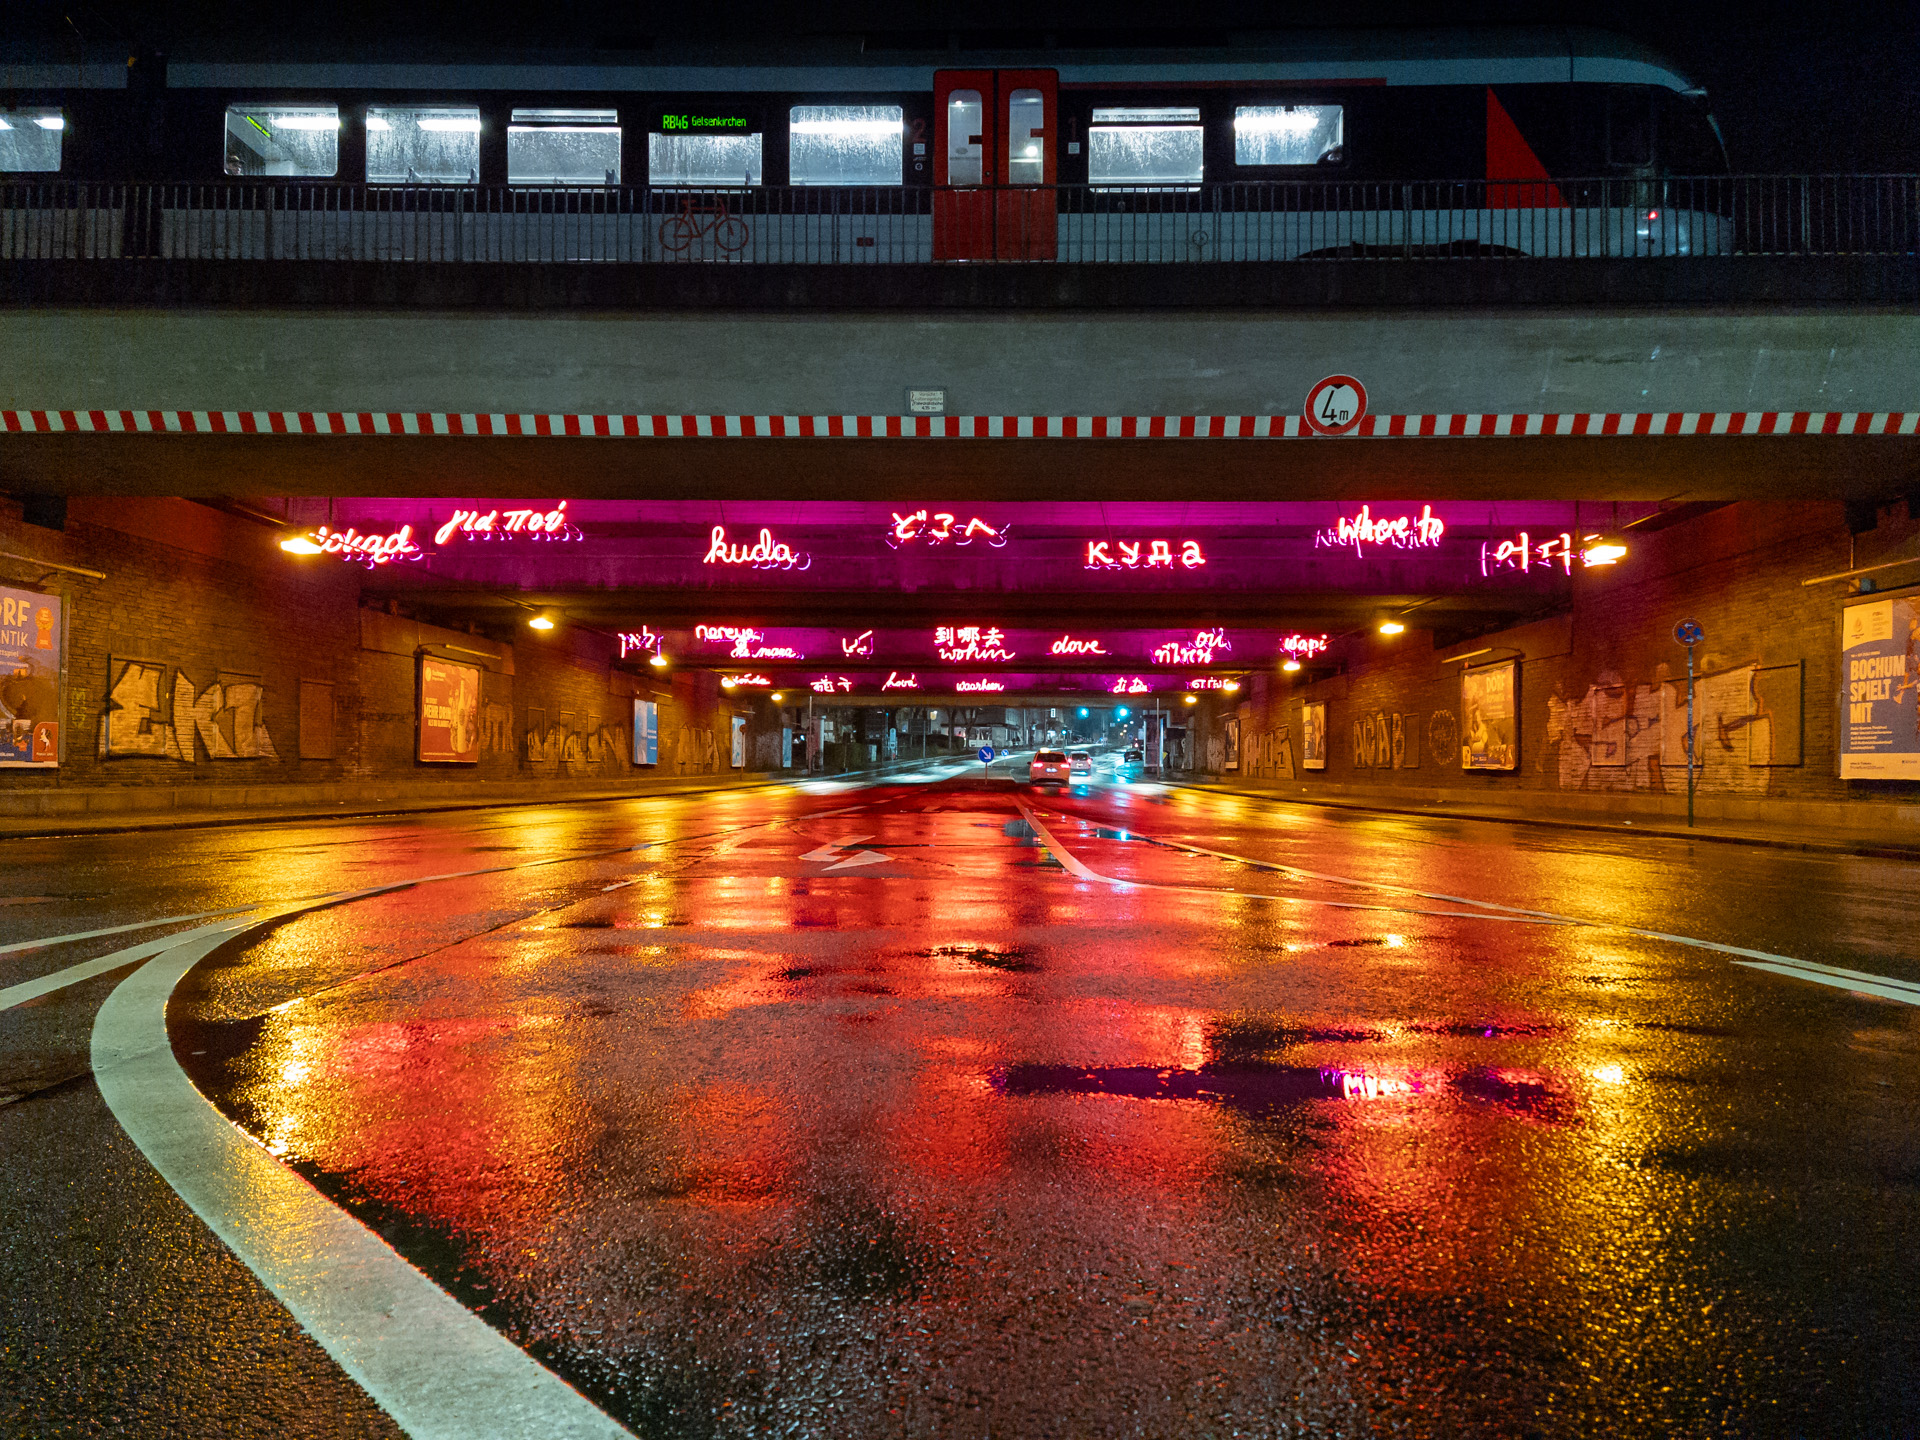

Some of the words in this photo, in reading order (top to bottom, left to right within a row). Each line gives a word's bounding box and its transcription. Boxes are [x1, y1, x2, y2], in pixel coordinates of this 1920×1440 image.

[663, 115, 688, 129] RB46
[691, 116, 747, 127] Gelsenkirchen
[912, 118, 926, 142] 2
[1338, 505, 1409, 541] where
[1417, 505, 1443, 542] to
[703, 526, 797, 563] kuda
[0, 597, 31, 627] RF
[934, 627, 1004, 647] 到哪去
[1052, 635, 1106, 655] dove
[939, 641, 1016, 660] wohin
[1850, 655, 1906, 681] BOCHUM
[956, 678, 1004, 691] waarheen
[1850, 679, 1892, 702] SPIELT
[1850, 702, 1873, 724] MIT
